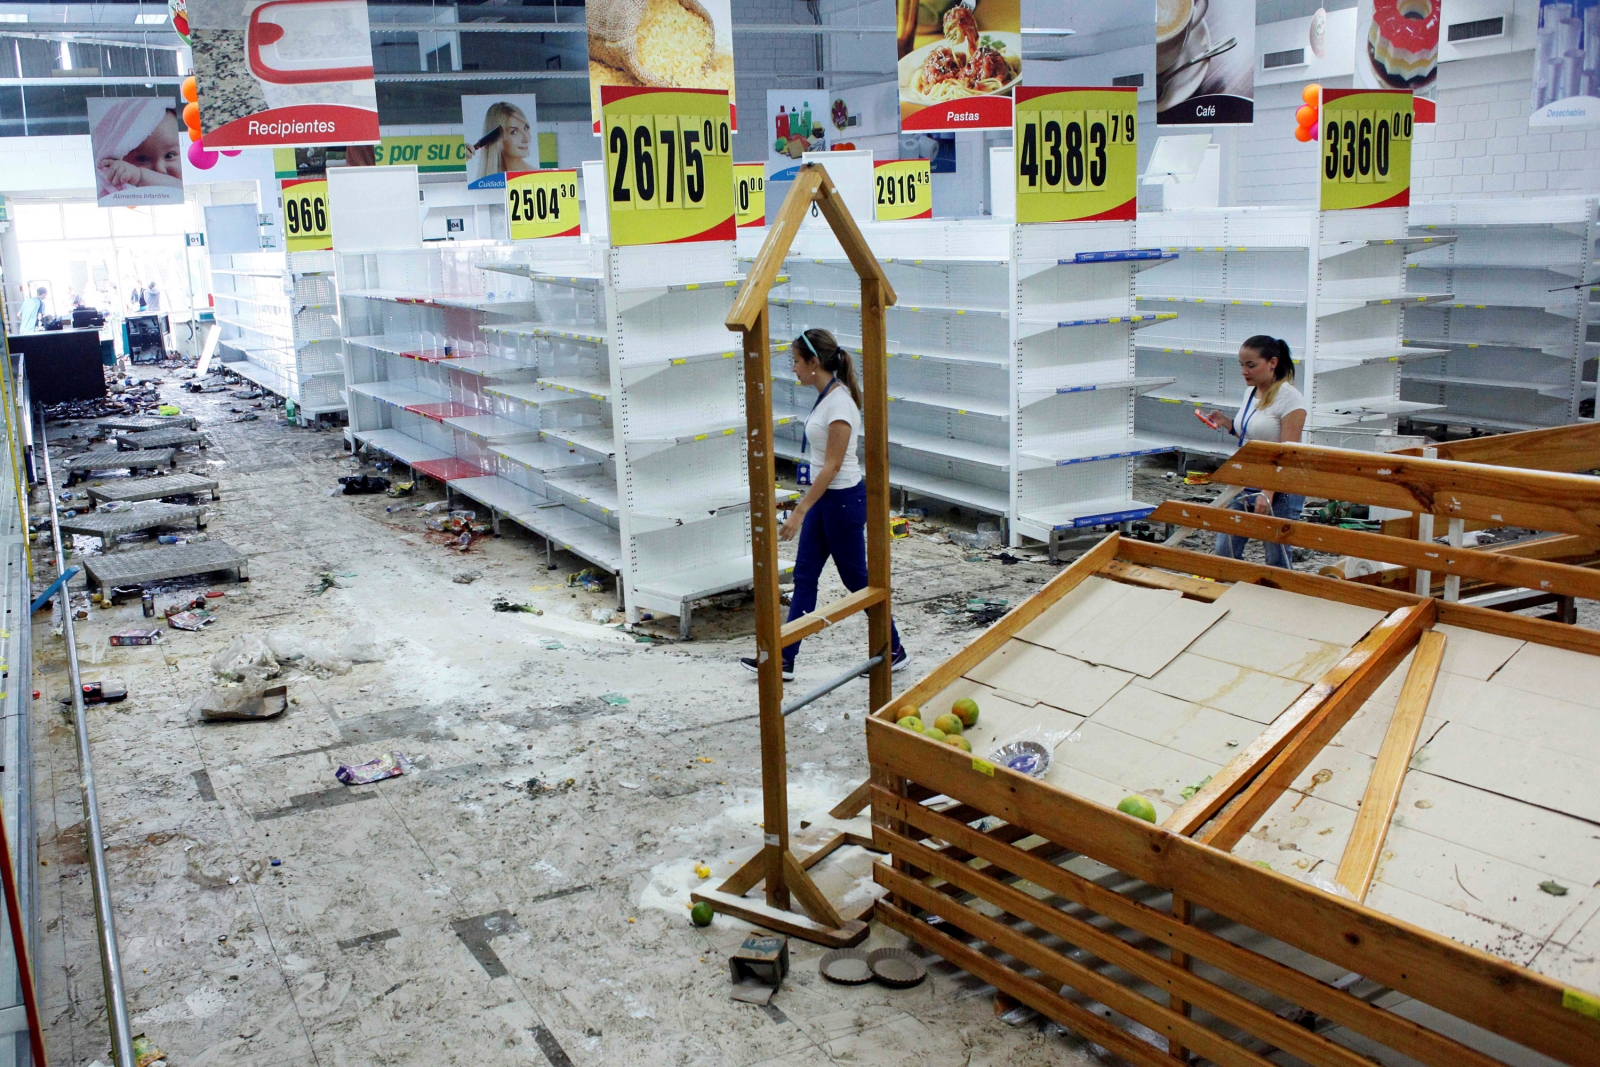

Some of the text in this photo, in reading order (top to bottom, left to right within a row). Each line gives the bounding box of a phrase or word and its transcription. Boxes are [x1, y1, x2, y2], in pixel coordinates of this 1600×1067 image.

[946, 111, 980, 122] Pastas
[1195, 104, 1216, 117] Café
[1546, 109, 1586, 118] Desechables
[248, 119, 336, 138] Recipientes
[389, 143, 423, 166] por
[426, 143, 451, 161] su
[478, 180, 505, 188] Cuidado
[286, 196, 327, 235] 966
[450, 221, 460, 229] 04
